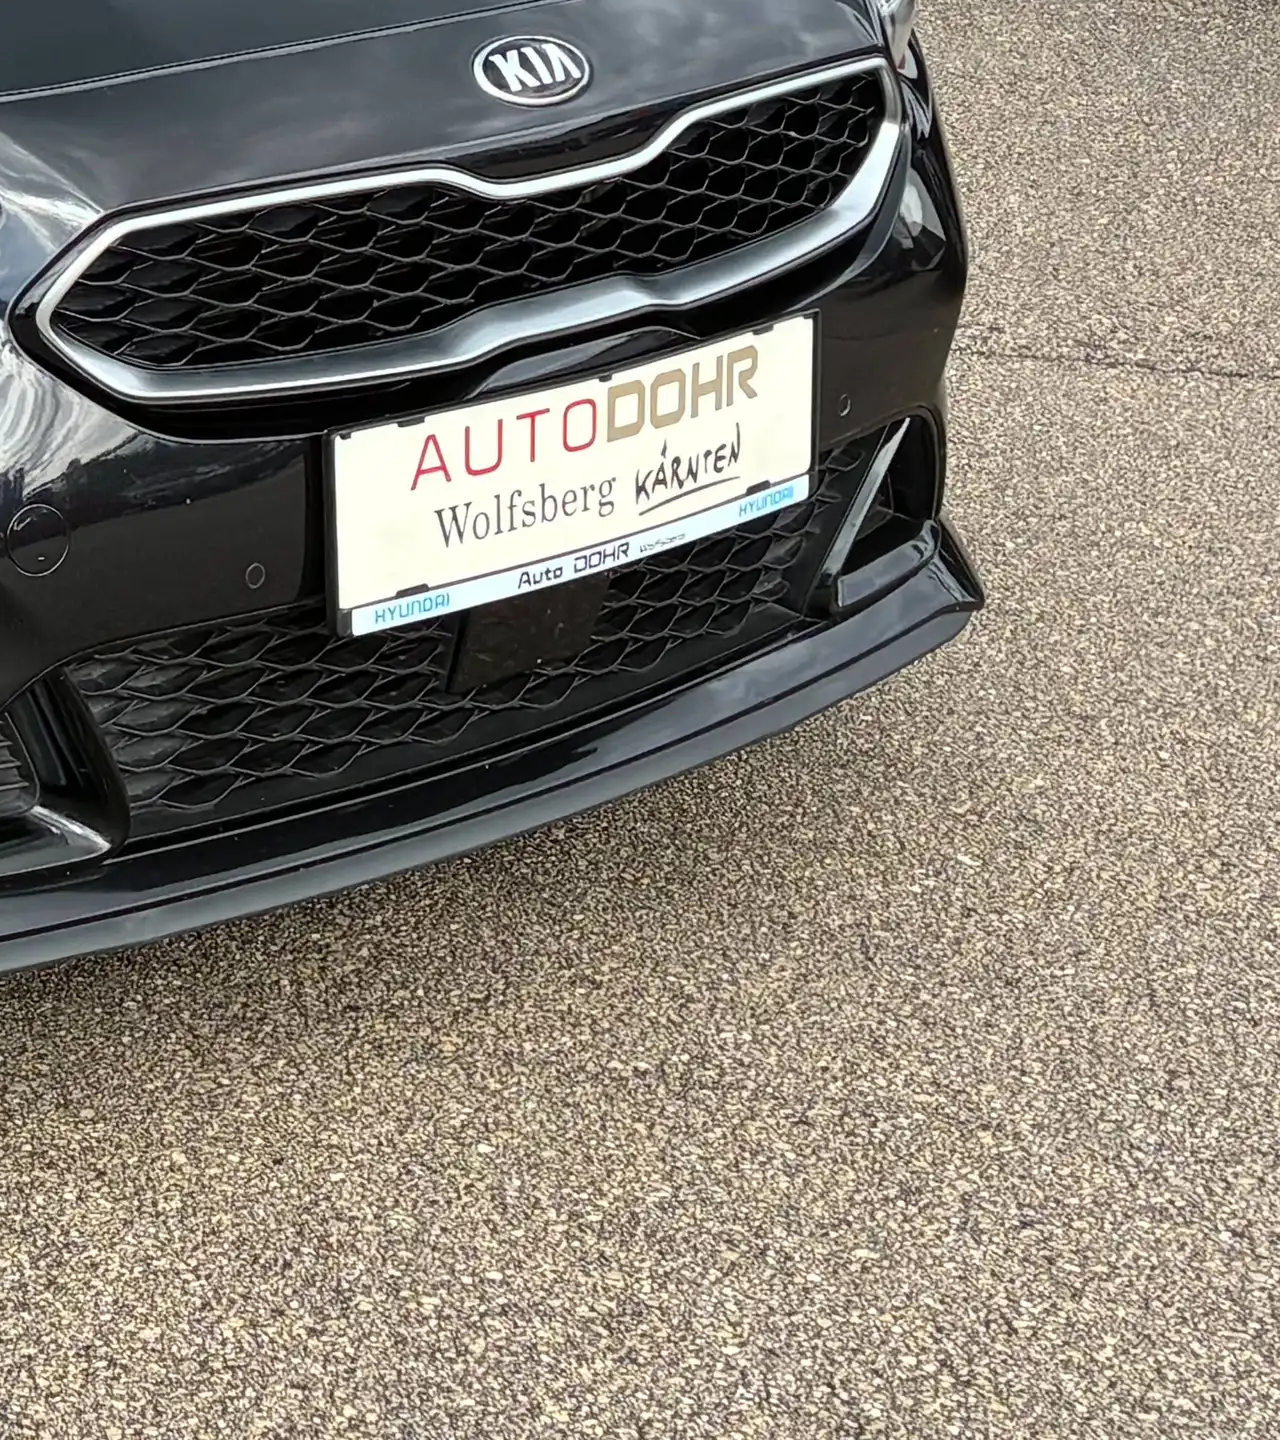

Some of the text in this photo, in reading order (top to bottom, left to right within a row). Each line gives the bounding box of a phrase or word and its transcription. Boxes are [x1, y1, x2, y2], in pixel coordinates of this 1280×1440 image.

[488, 42, 582, 93] KIA
[435, 477, 617, 549] Wolfsberg
[738, 486, 794, 517] HYUNDAI
[518, 566, 564, 589] Auto
[574, 541, 631, 574] DOHR
[374, 593, 450, 625] HYUNDAI
